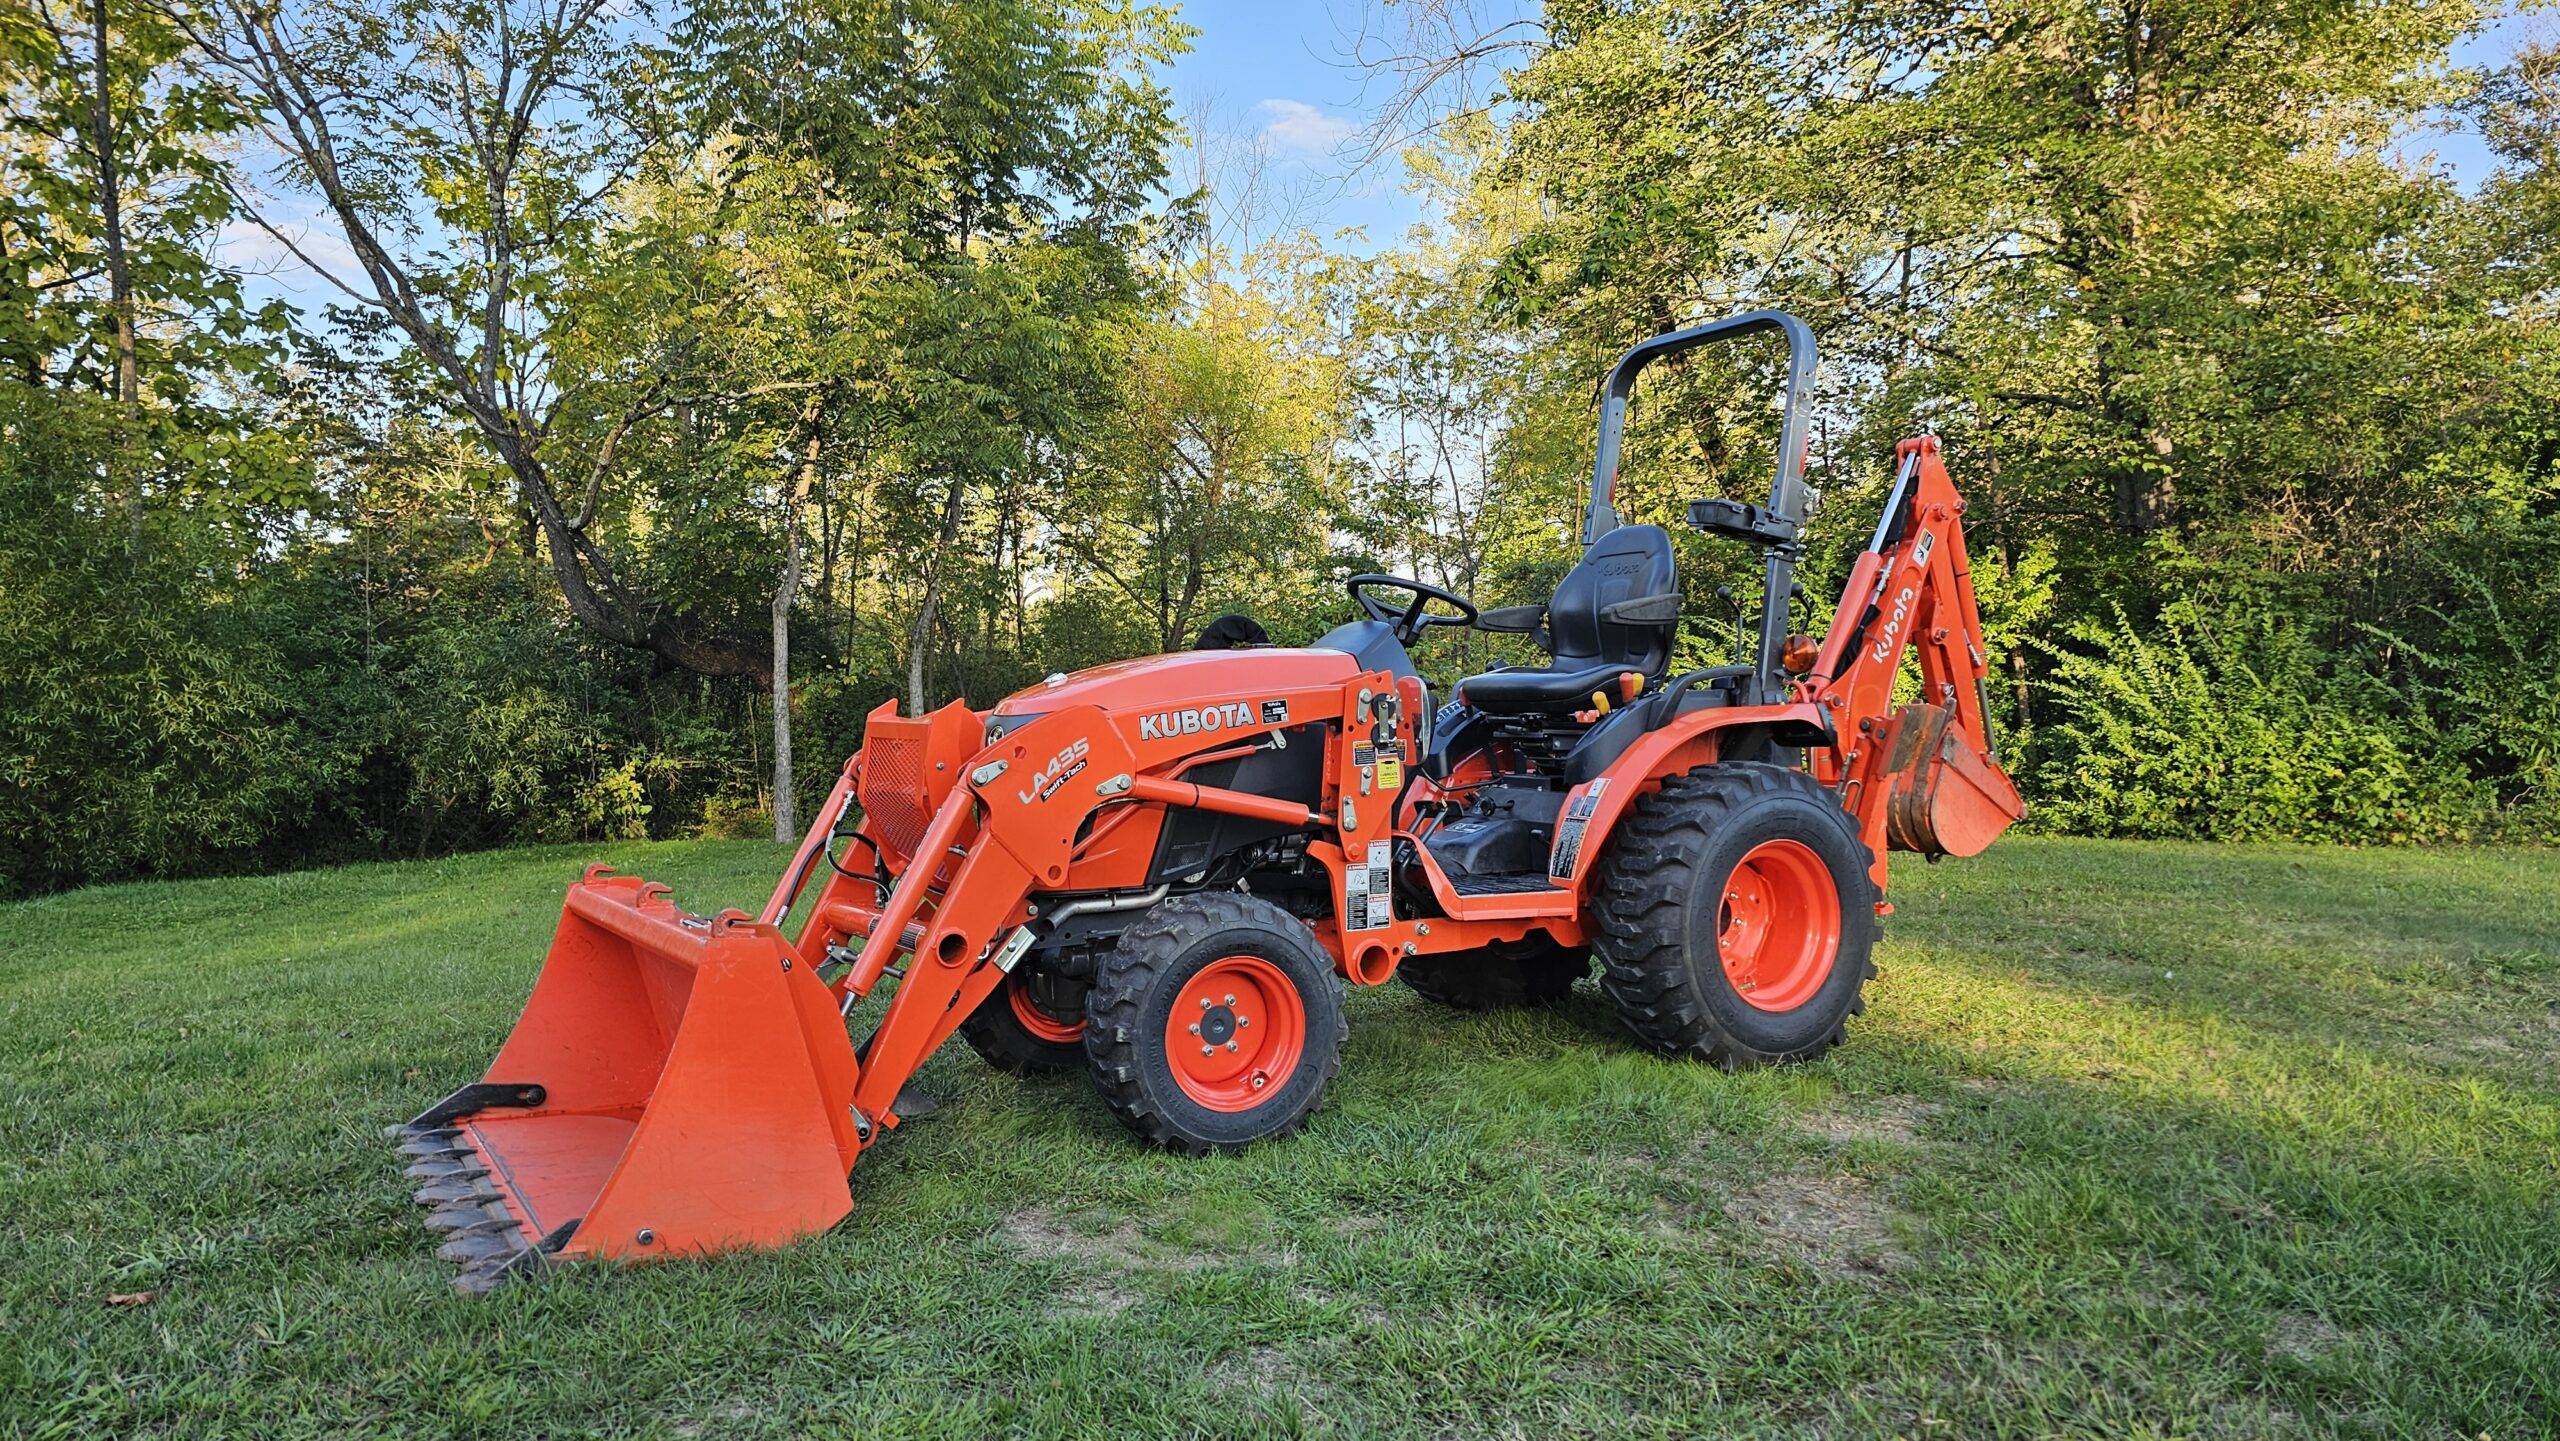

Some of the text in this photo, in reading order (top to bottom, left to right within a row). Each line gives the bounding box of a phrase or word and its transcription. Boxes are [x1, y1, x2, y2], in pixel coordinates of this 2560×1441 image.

[1872, 587, 1914, 664] Kubota
[1139, 702, 1256, 741] KUBOTA
[1018, 736, 1090, 805] LA435
[1042, 760, 1087, 800] Swift-Tach
